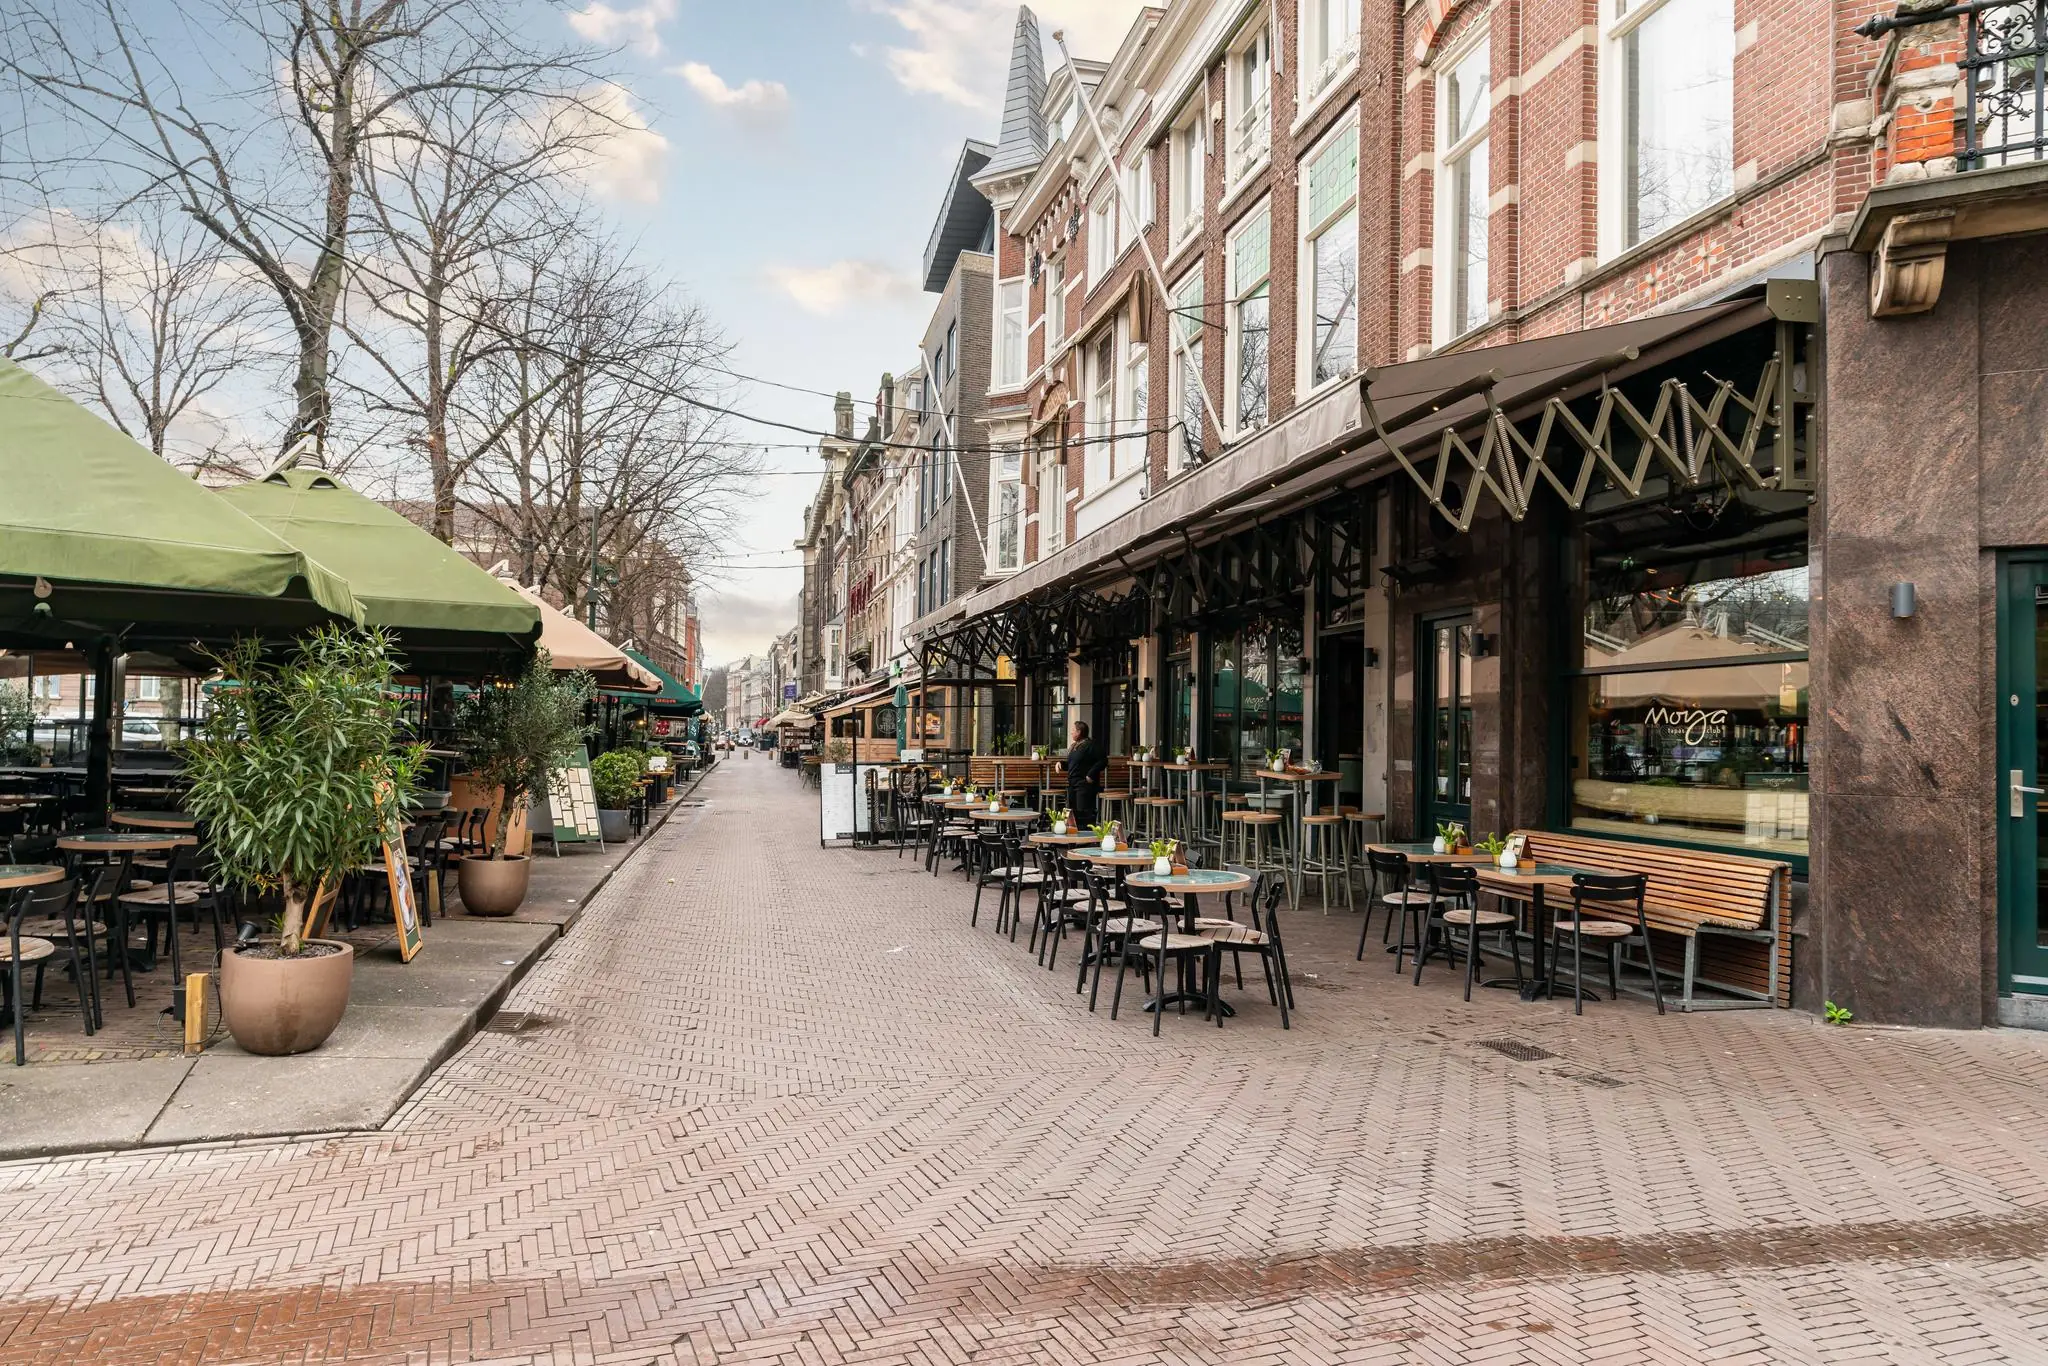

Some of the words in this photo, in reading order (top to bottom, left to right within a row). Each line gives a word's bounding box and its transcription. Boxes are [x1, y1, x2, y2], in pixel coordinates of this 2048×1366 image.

[1644, 707, 1728, 746] Moya
[1667, 727, 1685, 735] tapas
[1706, 725, 1721, 734] club
